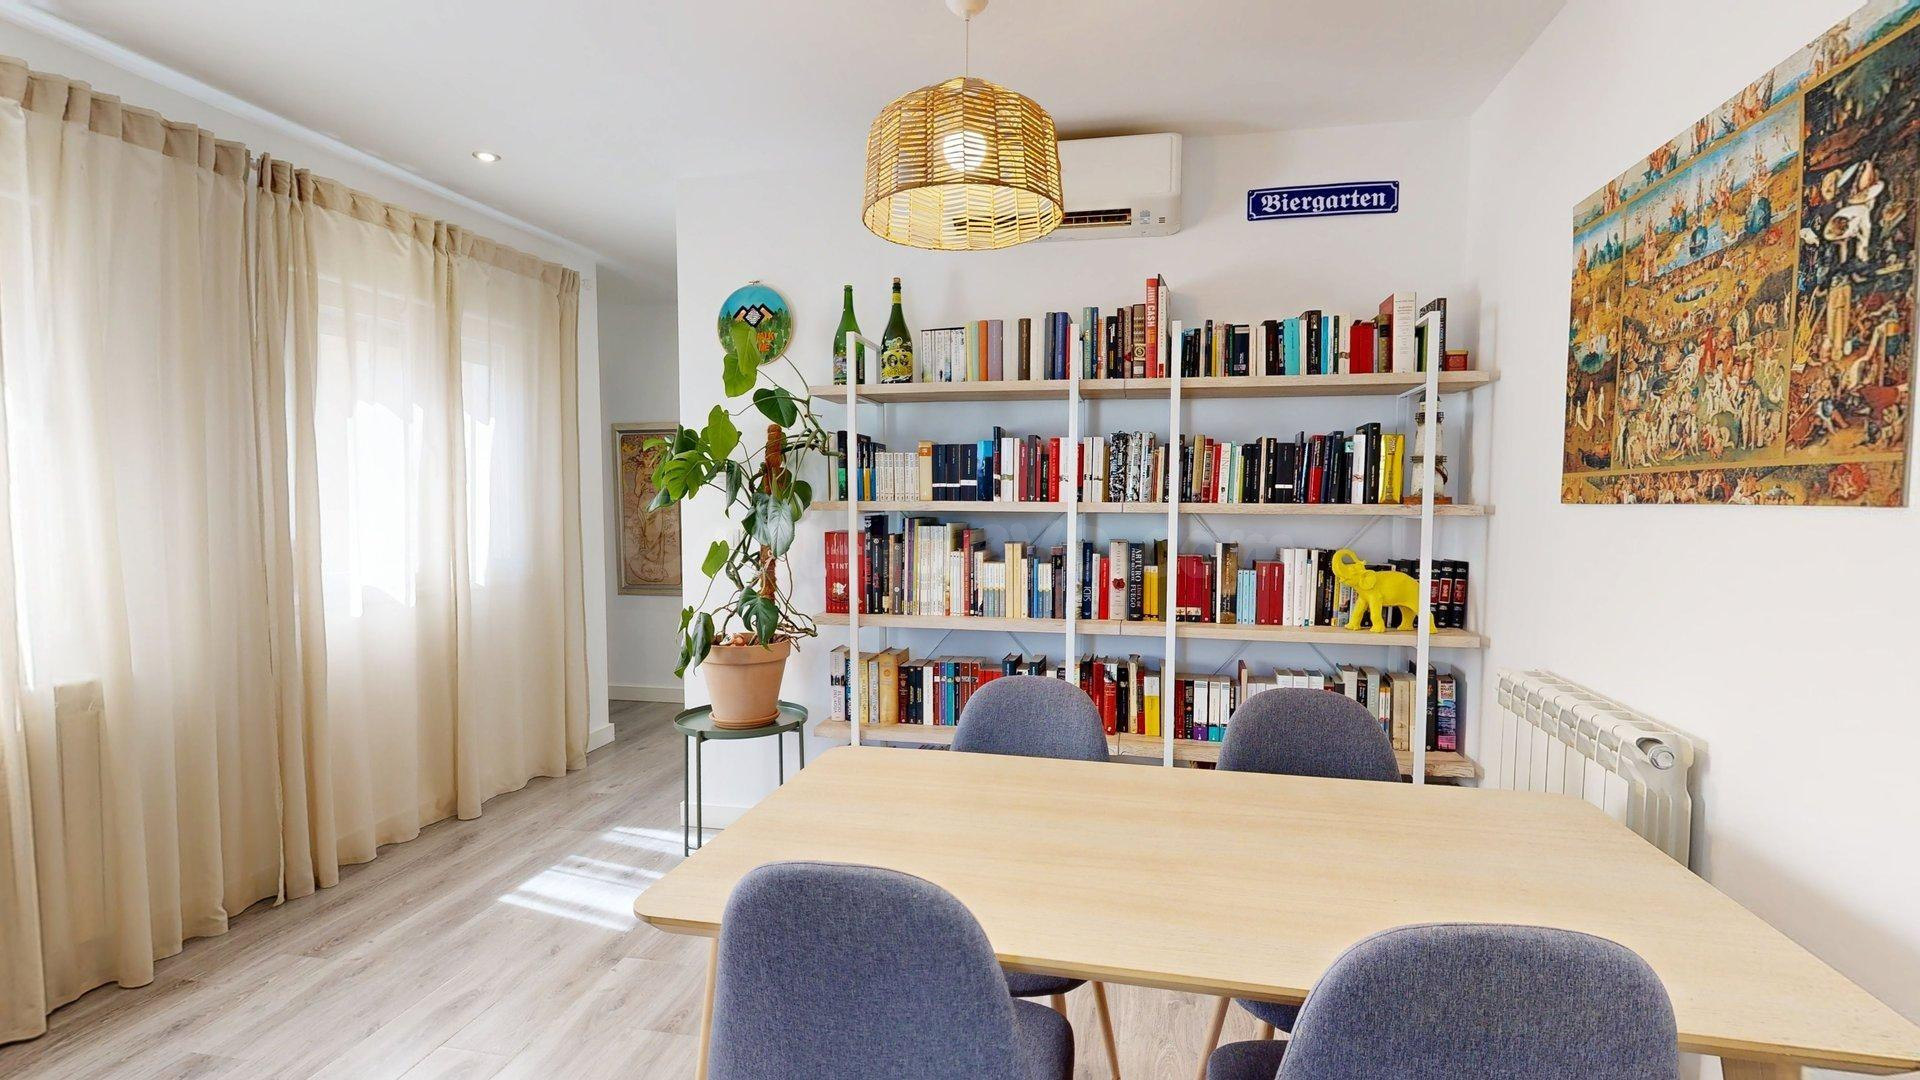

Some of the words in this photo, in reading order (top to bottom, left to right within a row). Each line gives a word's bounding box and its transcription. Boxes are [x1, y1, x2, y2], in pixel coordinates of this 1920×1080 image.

[1260, 187, 1387, 214] Biergarten
[1147, 305, 1156, 328] CASH
[1134, 548, 1143, 582] ARTURO
[1082, 586, 1092, 602] SIDI
